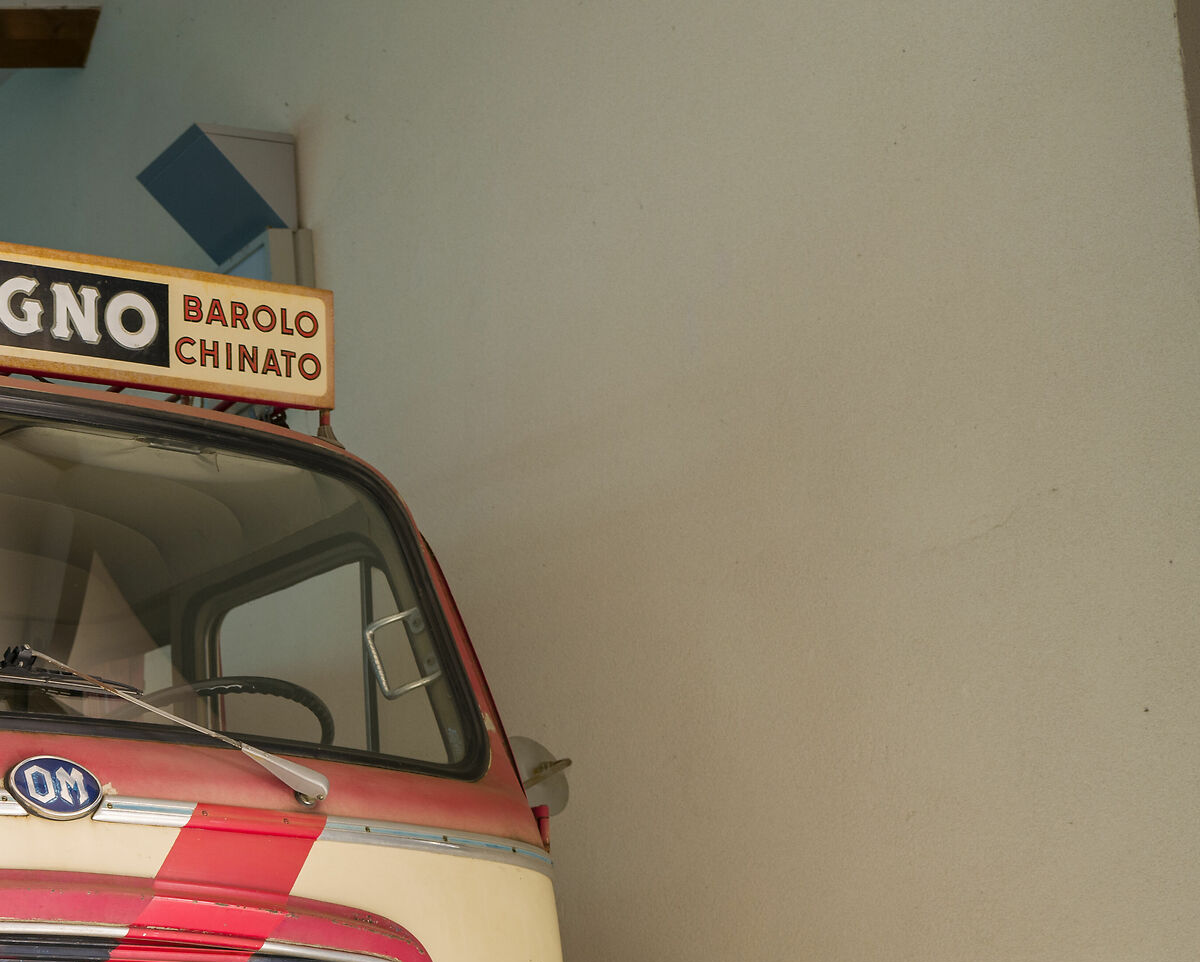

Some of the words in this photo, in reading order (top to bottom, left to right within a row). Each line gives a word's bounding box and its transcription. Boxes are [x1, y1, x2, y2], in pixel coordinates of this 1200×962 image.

[183, 294, 319, 338] BAROLO
[174, 336, 321, 381] CHINATO
[24, 764, 88, 807] OM
